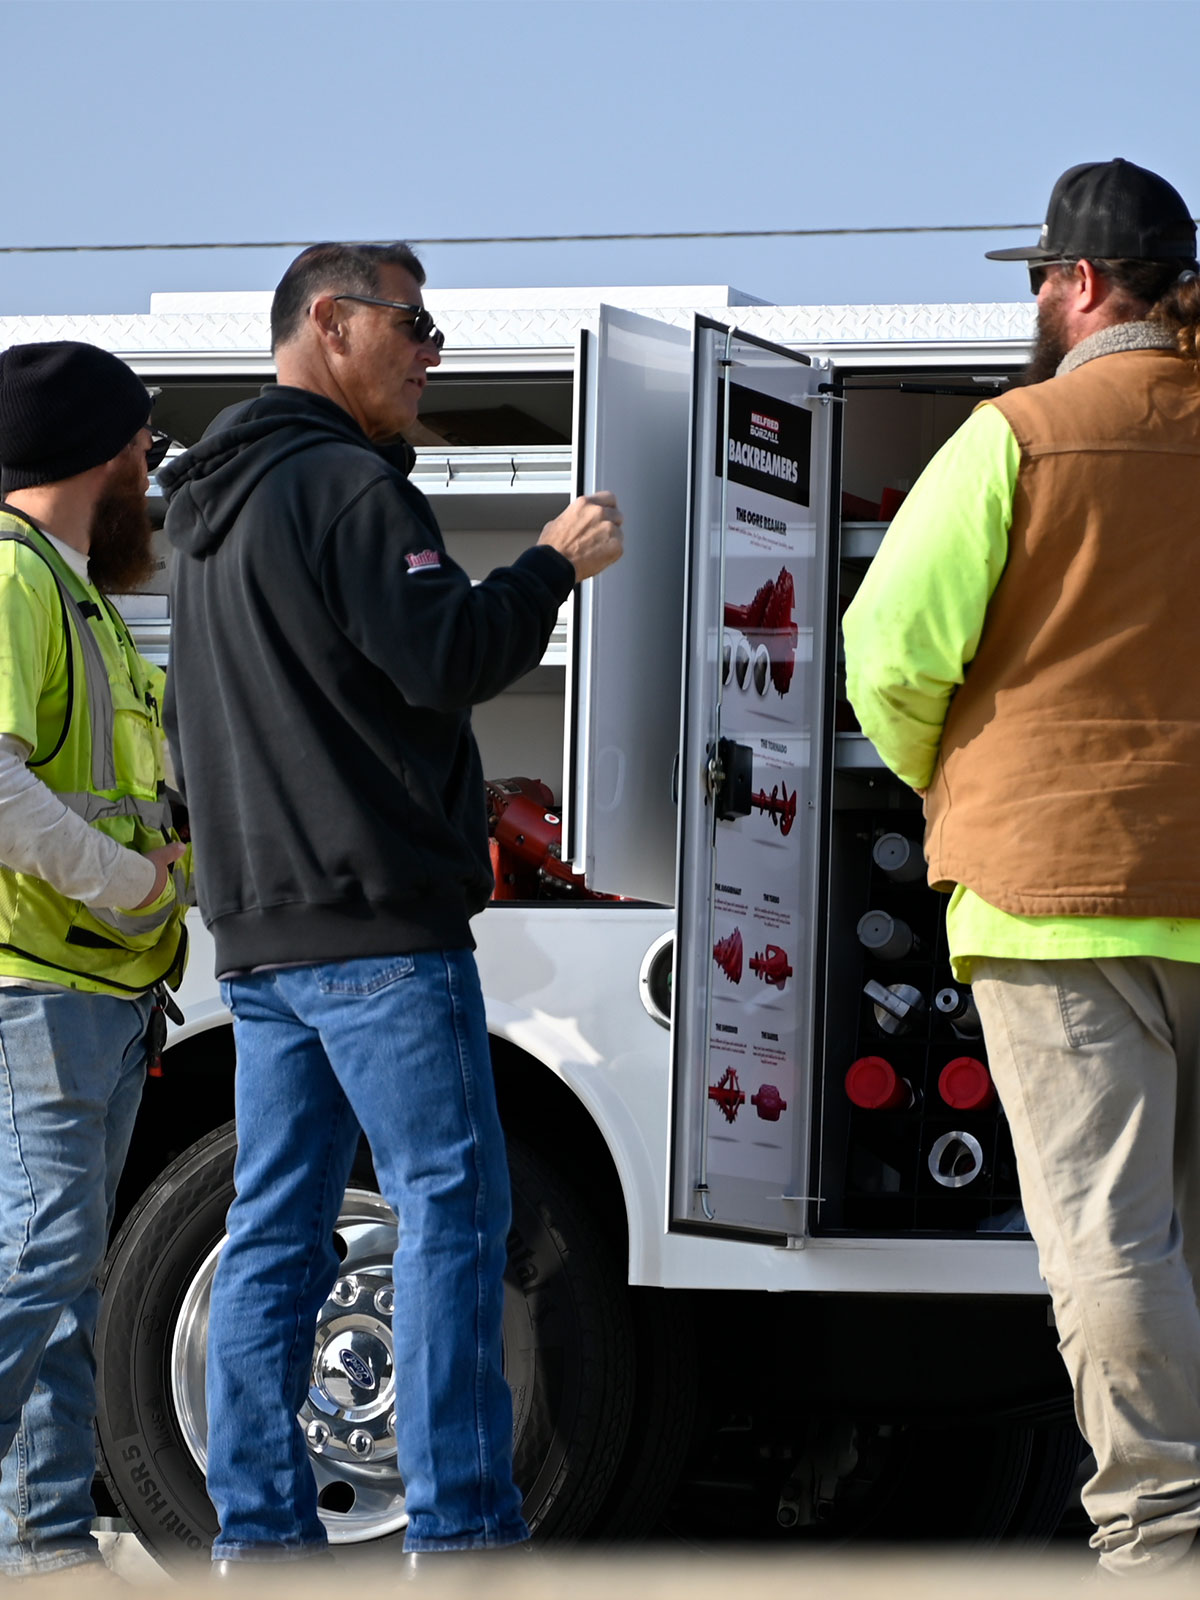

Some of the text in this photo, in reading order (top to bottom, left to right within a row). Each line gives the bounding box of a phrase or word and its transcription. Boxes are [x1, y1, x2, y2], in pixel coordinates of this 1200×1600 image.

[728, 438, 798, 484] BACKREAMERS
[736, 507, 787, 536] THE OGRE REAMER
[121, 1444, 142, 1463] 5
[130, 1461, 167, 1515] HSR
[159, 1509, 209, 1550] onti
